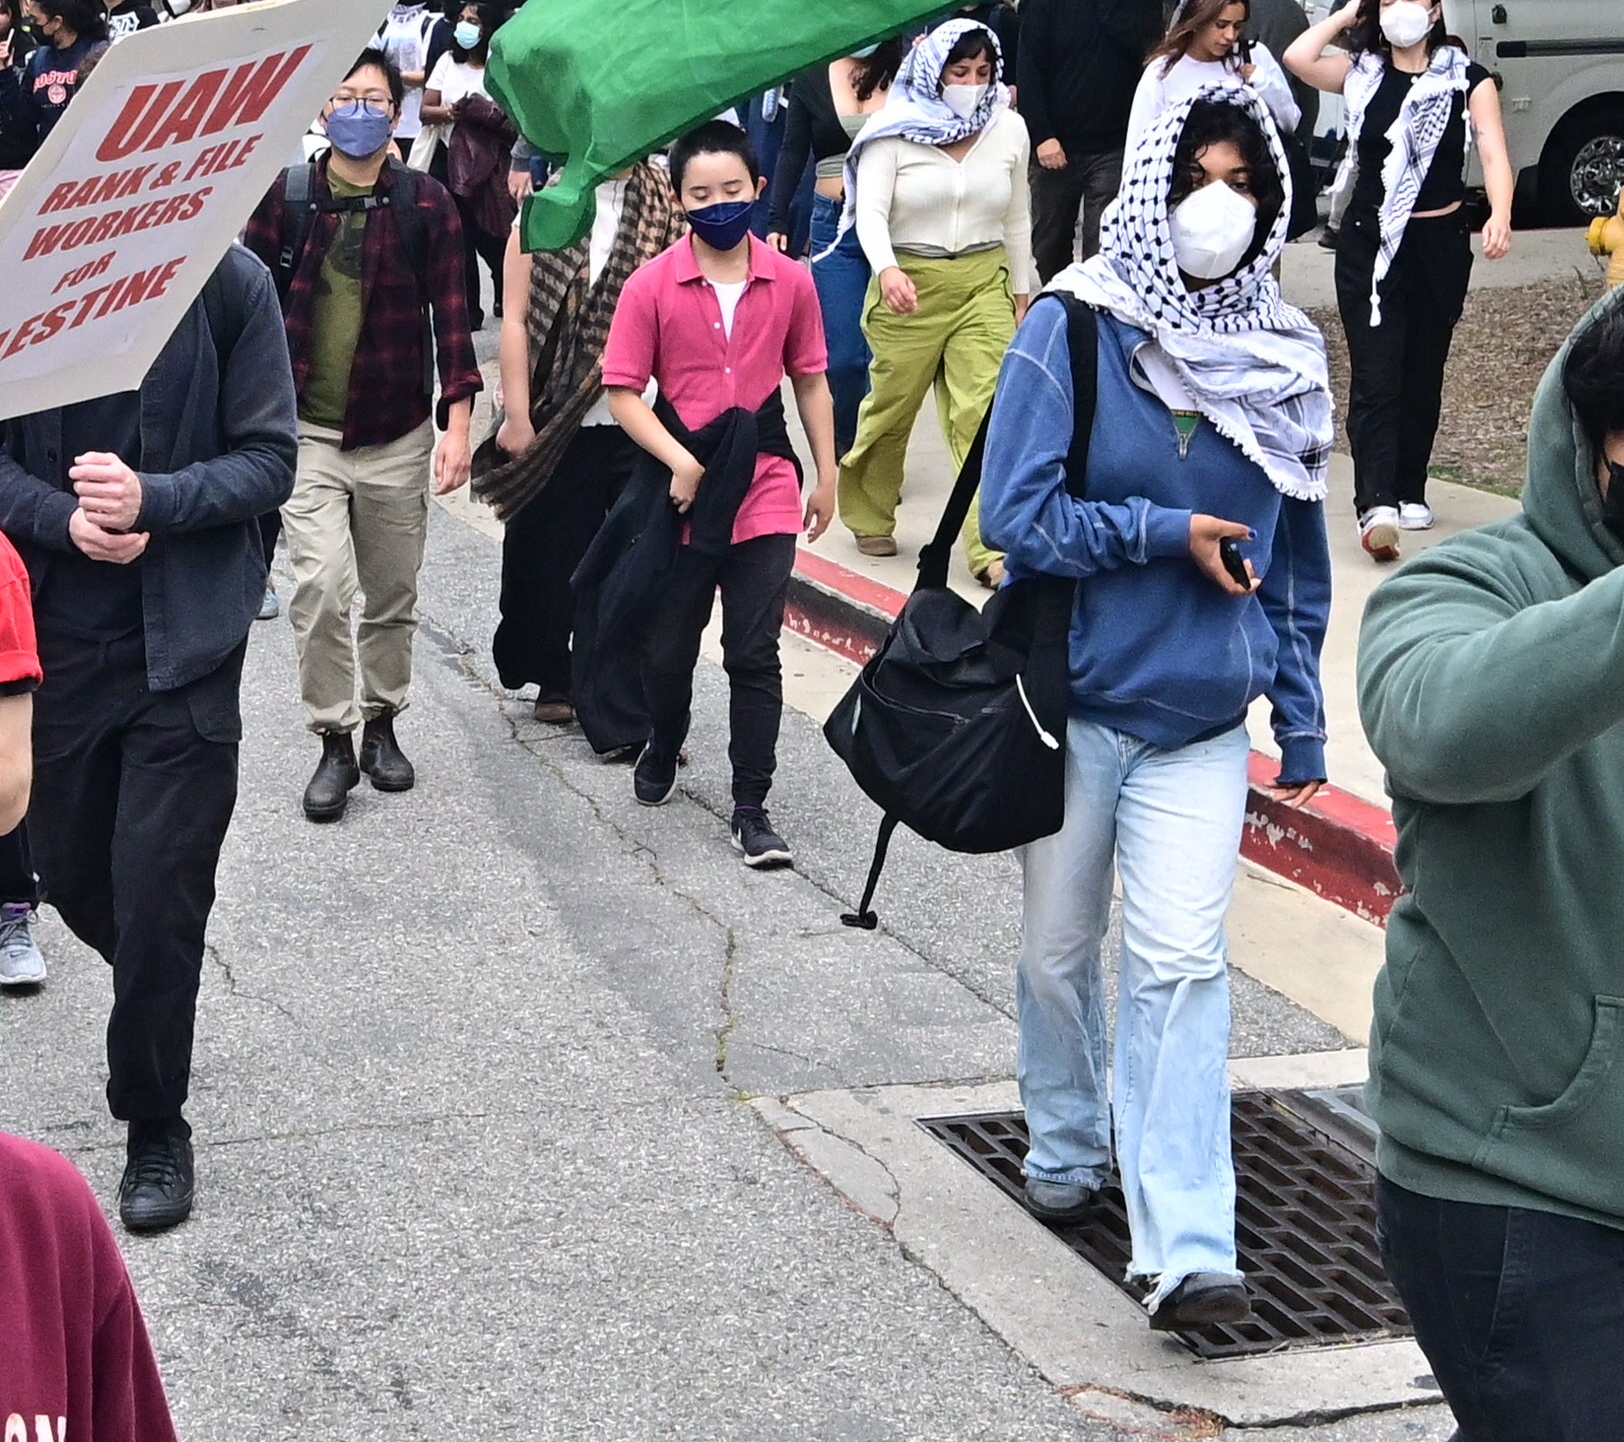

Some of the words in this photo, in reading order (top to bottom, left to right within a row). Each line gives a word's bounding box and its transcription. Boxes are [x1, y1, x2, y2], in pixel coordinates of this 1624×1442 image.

[95, 43, 314, 162] UAW
[36, 162, 153, 216] RANK
[149, 160, 182, 191] &
[183, 133, 265, 182] FILE
[22, 185, 214, 261] WORKERS
[51, 250, 117, 295] FOR
